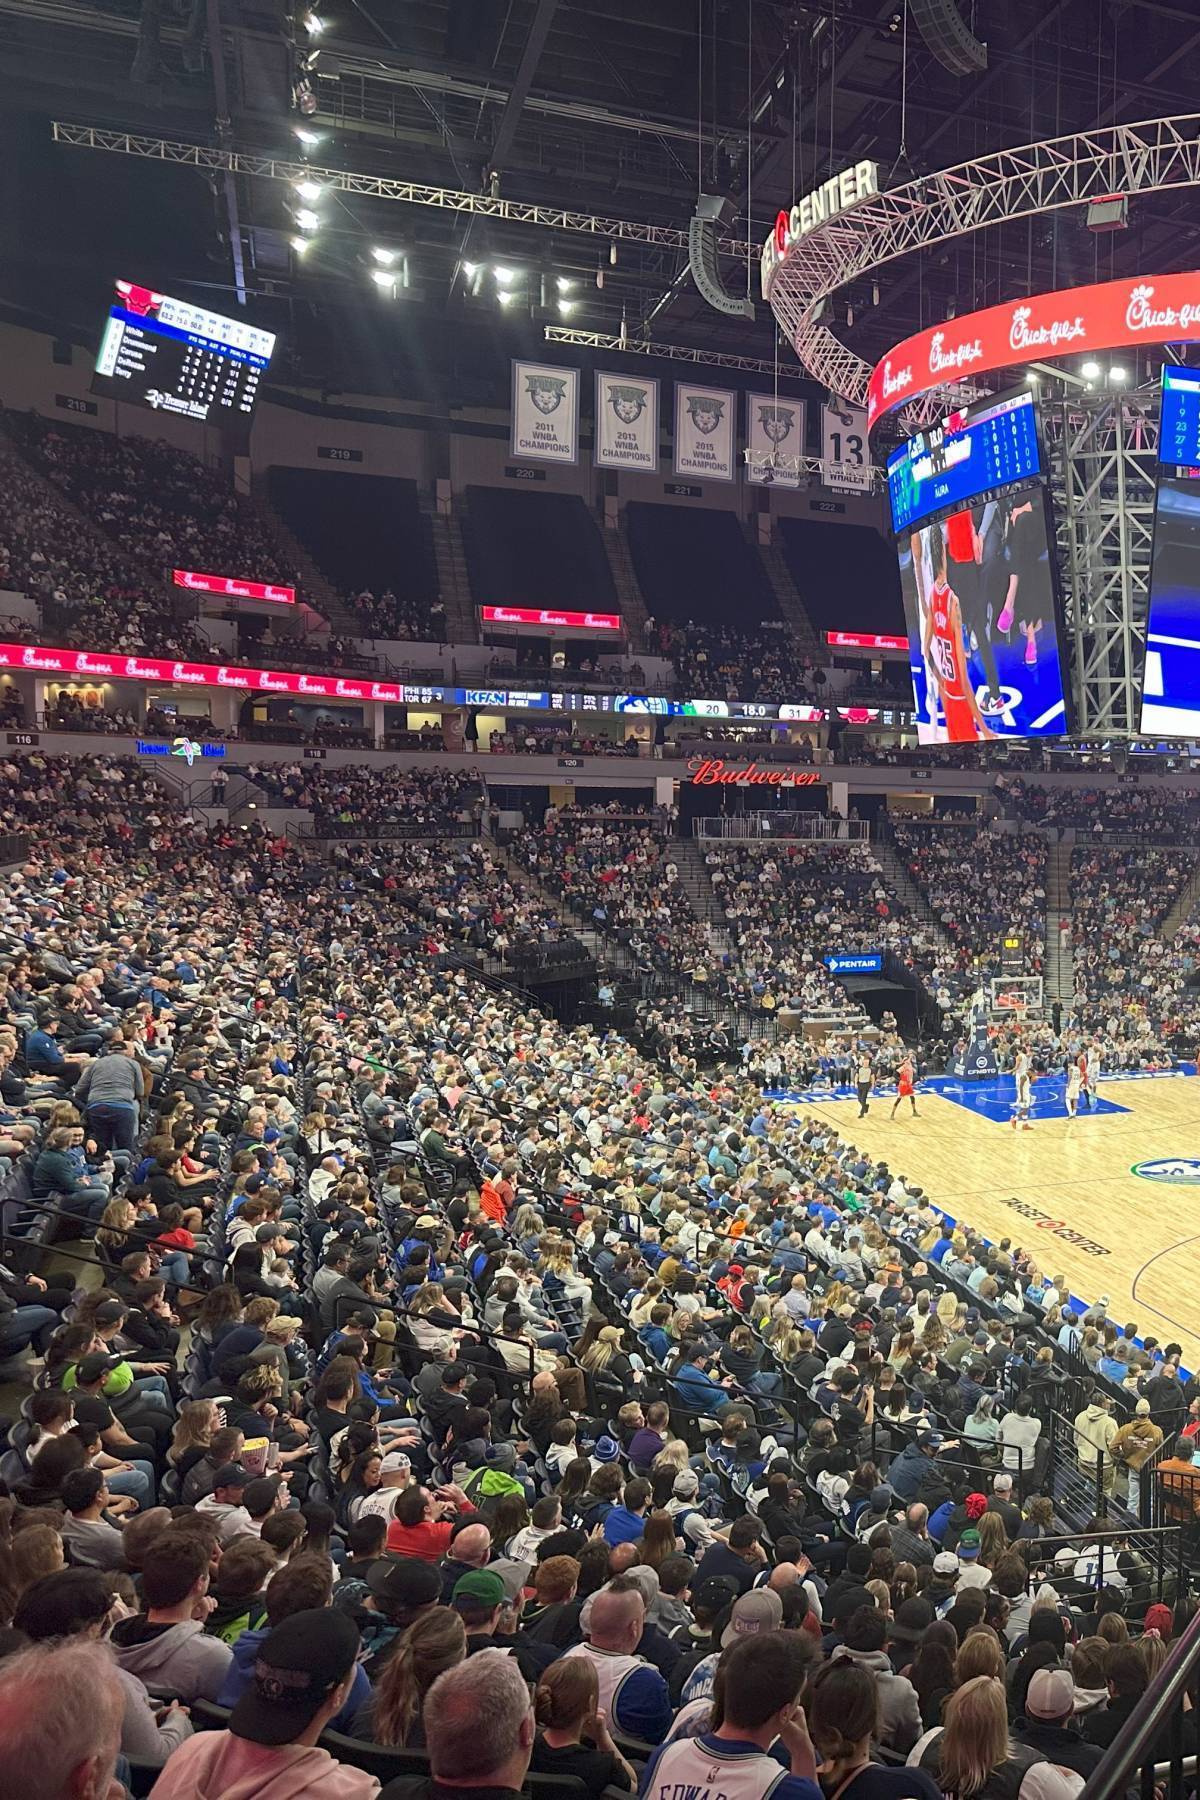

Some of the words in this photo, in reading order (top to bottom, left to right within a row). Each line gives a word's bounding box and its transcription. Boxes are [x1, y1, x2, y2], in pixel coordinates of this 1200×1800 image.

[789, 159, 878, 240] CENTER
[125, 325, 144, 338] White
[115, 366, 132, 379] Terry
[1179, 409, 1186, 418] 9
[535, 422, 554, 432] 2011
[1176, 422, 1187, 431] 23
[532, 432, 558, 442] WNBA
[617, 431, 637, 442] 2013
[929, 428, 943, 448] 18.0
[1175, 435, 1186, 444] 27
[519, 439, 570, 453] CHAMPIONS
[614, 441, 639, 451] WNBA
[695, 441, 714, 450] 2015
[830, 432, 864, 469] 13
[330, 449, 350, 460] 219
[602, 448, 651, 462] CHAMPIONS
[692, 450, 717, 460] WNBA
[1176, 448, 1183, 458] 5
[680, 458, 728, 472] CHAMPIONS
[516, 469, 534, 478] 220
[675, 486, 690, 495] 221
[404, 687, 419, 695] PHI
[422, 688, 432, 696] 85
[404, 695, 420, 703] TOR
[422, 696, 432, 704] 67
[466, 690, 506, 705] KFAN
[706, 704, 719, 714] 20
[742, 705, 766, 716] 18.0
[788, 708, 801, 718] 31
[15, 735, 32, 744] 116
[688, 759, 820, 786] Budweiser
[838, 959, 876, 968] PENTAIR
[999, 1197, 1052, 1220] TARGET
[1052, 1228, 1112, 1256] CENTER
